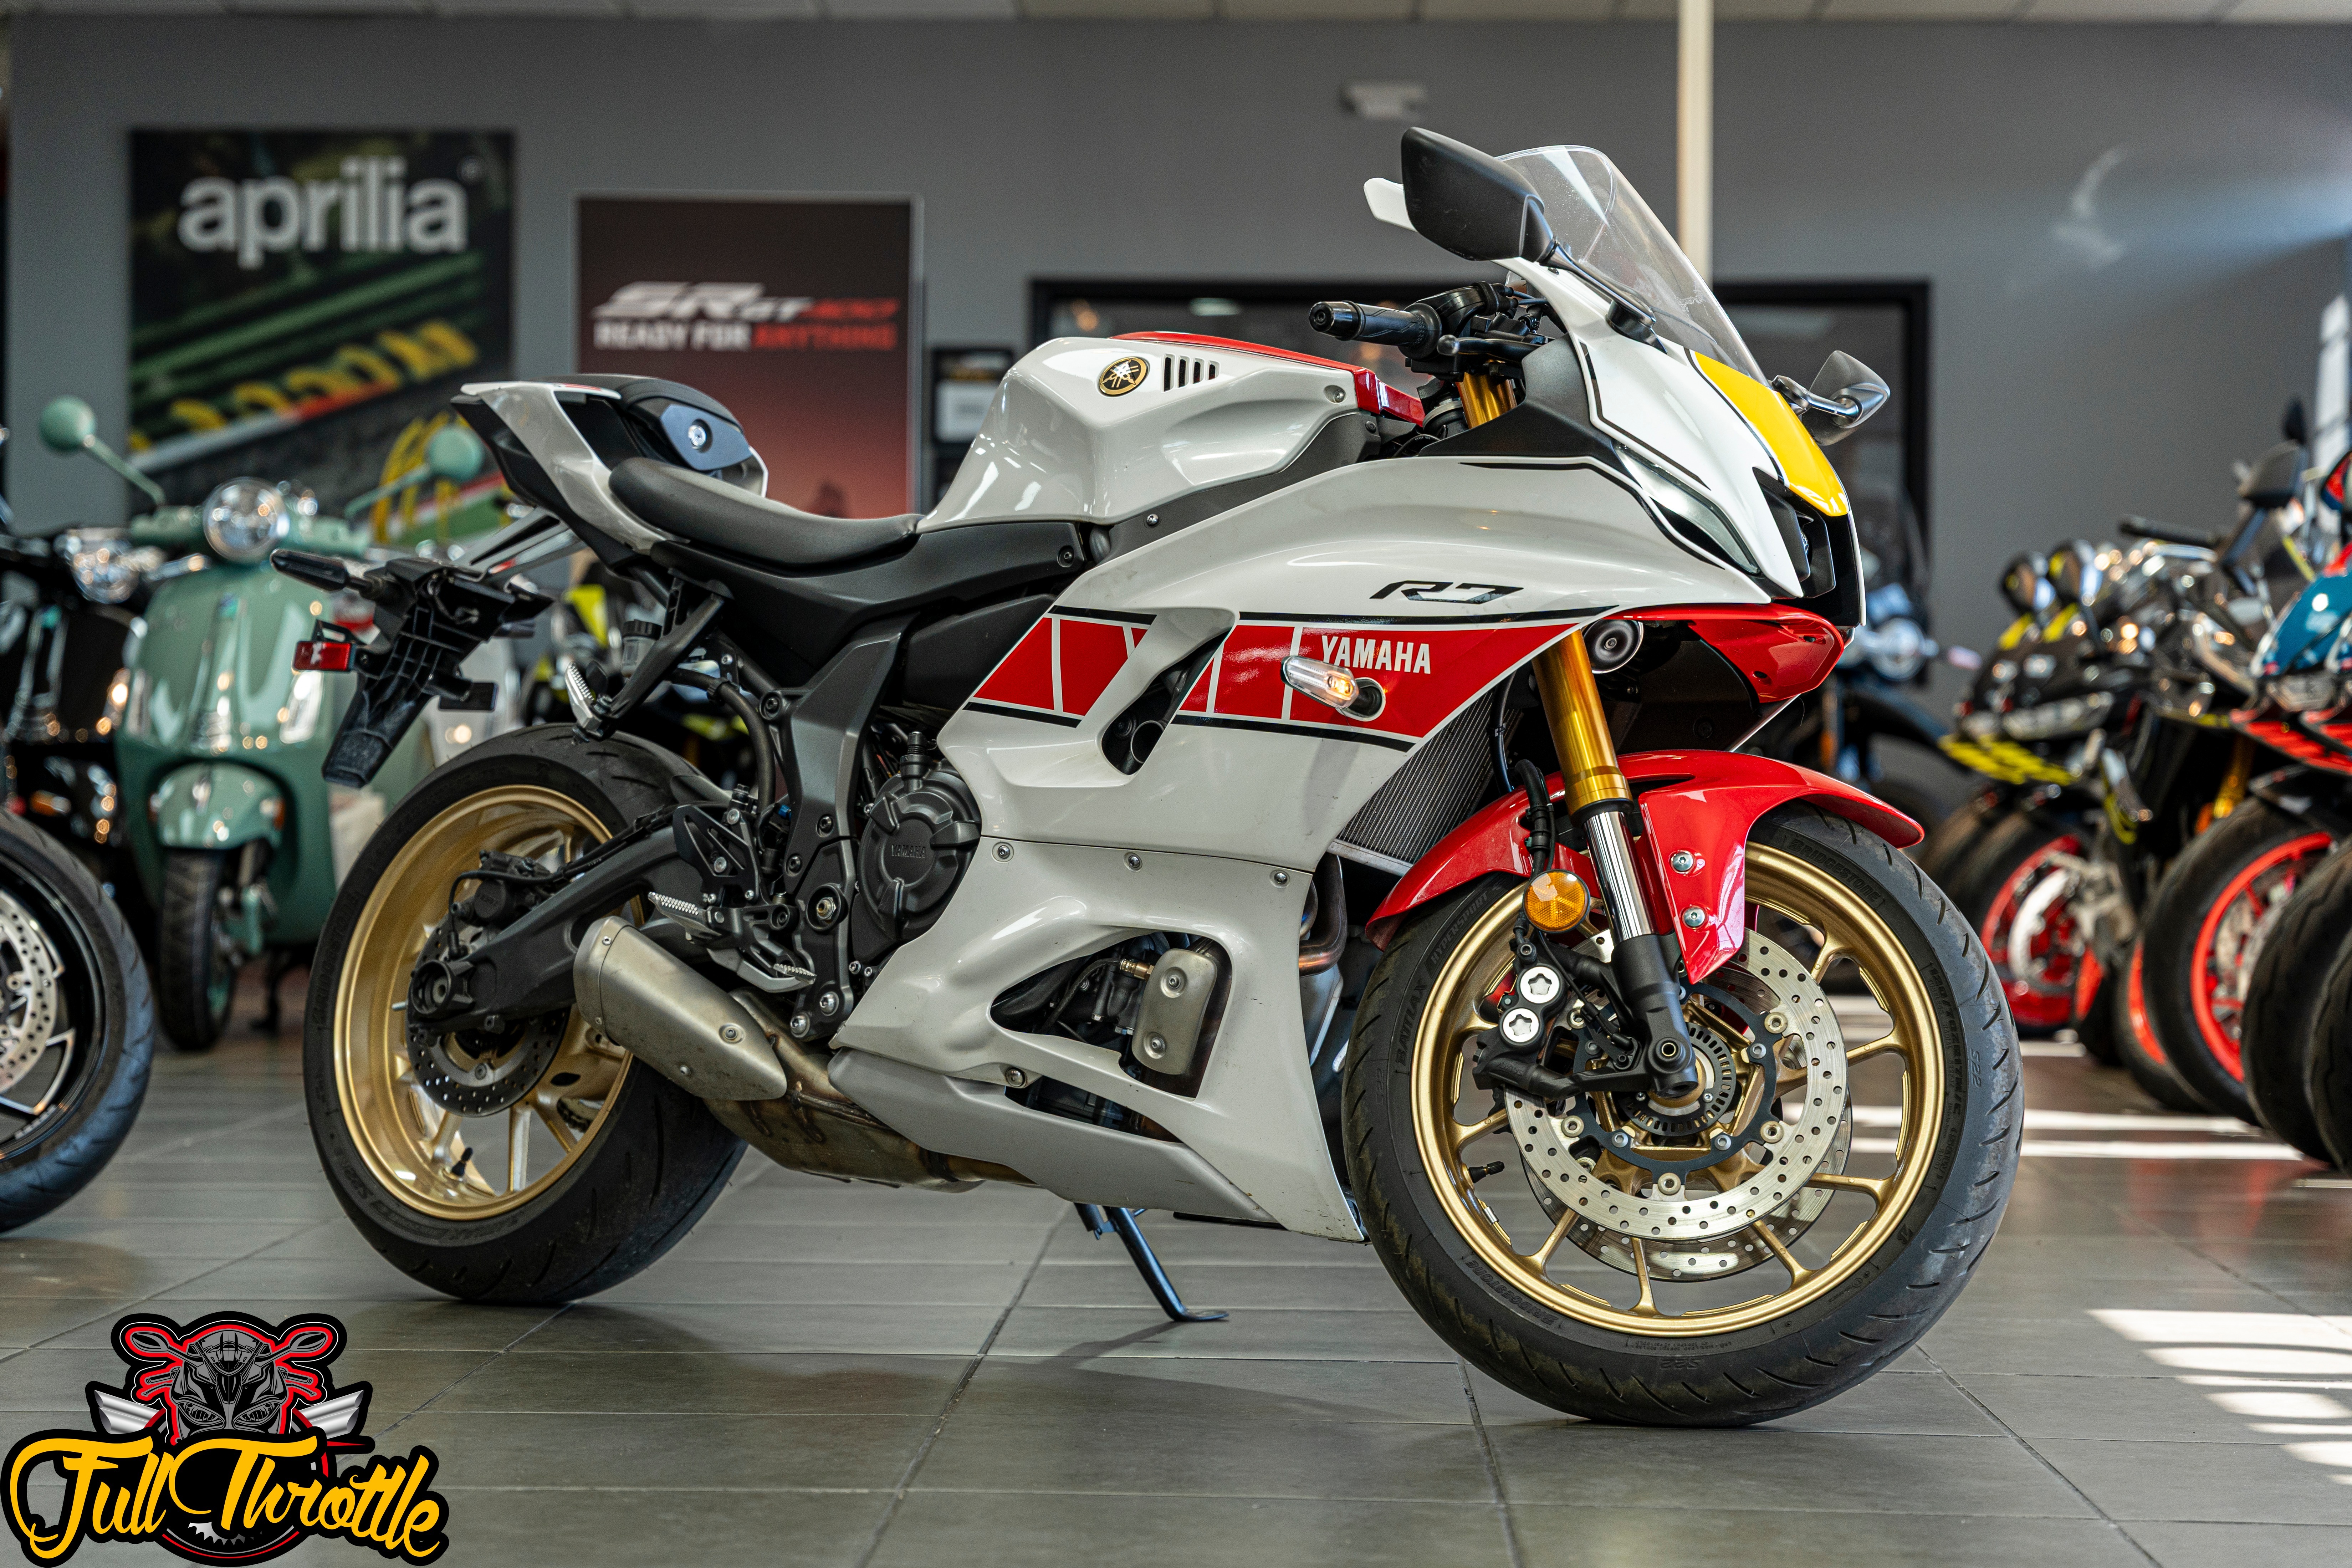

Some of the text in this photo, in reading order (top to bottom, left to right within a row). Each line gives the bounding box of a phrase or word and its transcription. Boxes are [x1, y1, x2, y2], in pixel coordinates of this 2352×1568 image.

[178, 155, 468, 270] aprilia
[1370, 580, 1524, 604] R7
[1321, 636, 1431, 674] YAMAHA
[891, 844, 926, 859] YAMAHA
[1787, 839, 1881, 903] BRIDGESTONE
[1395, 892, 1488, 1066] BATTLAX HYPERSPORT
[1970, 1048, 1982, 1088] S22
[1465, 1260, 1560, 1325] BRIDGESTONE
